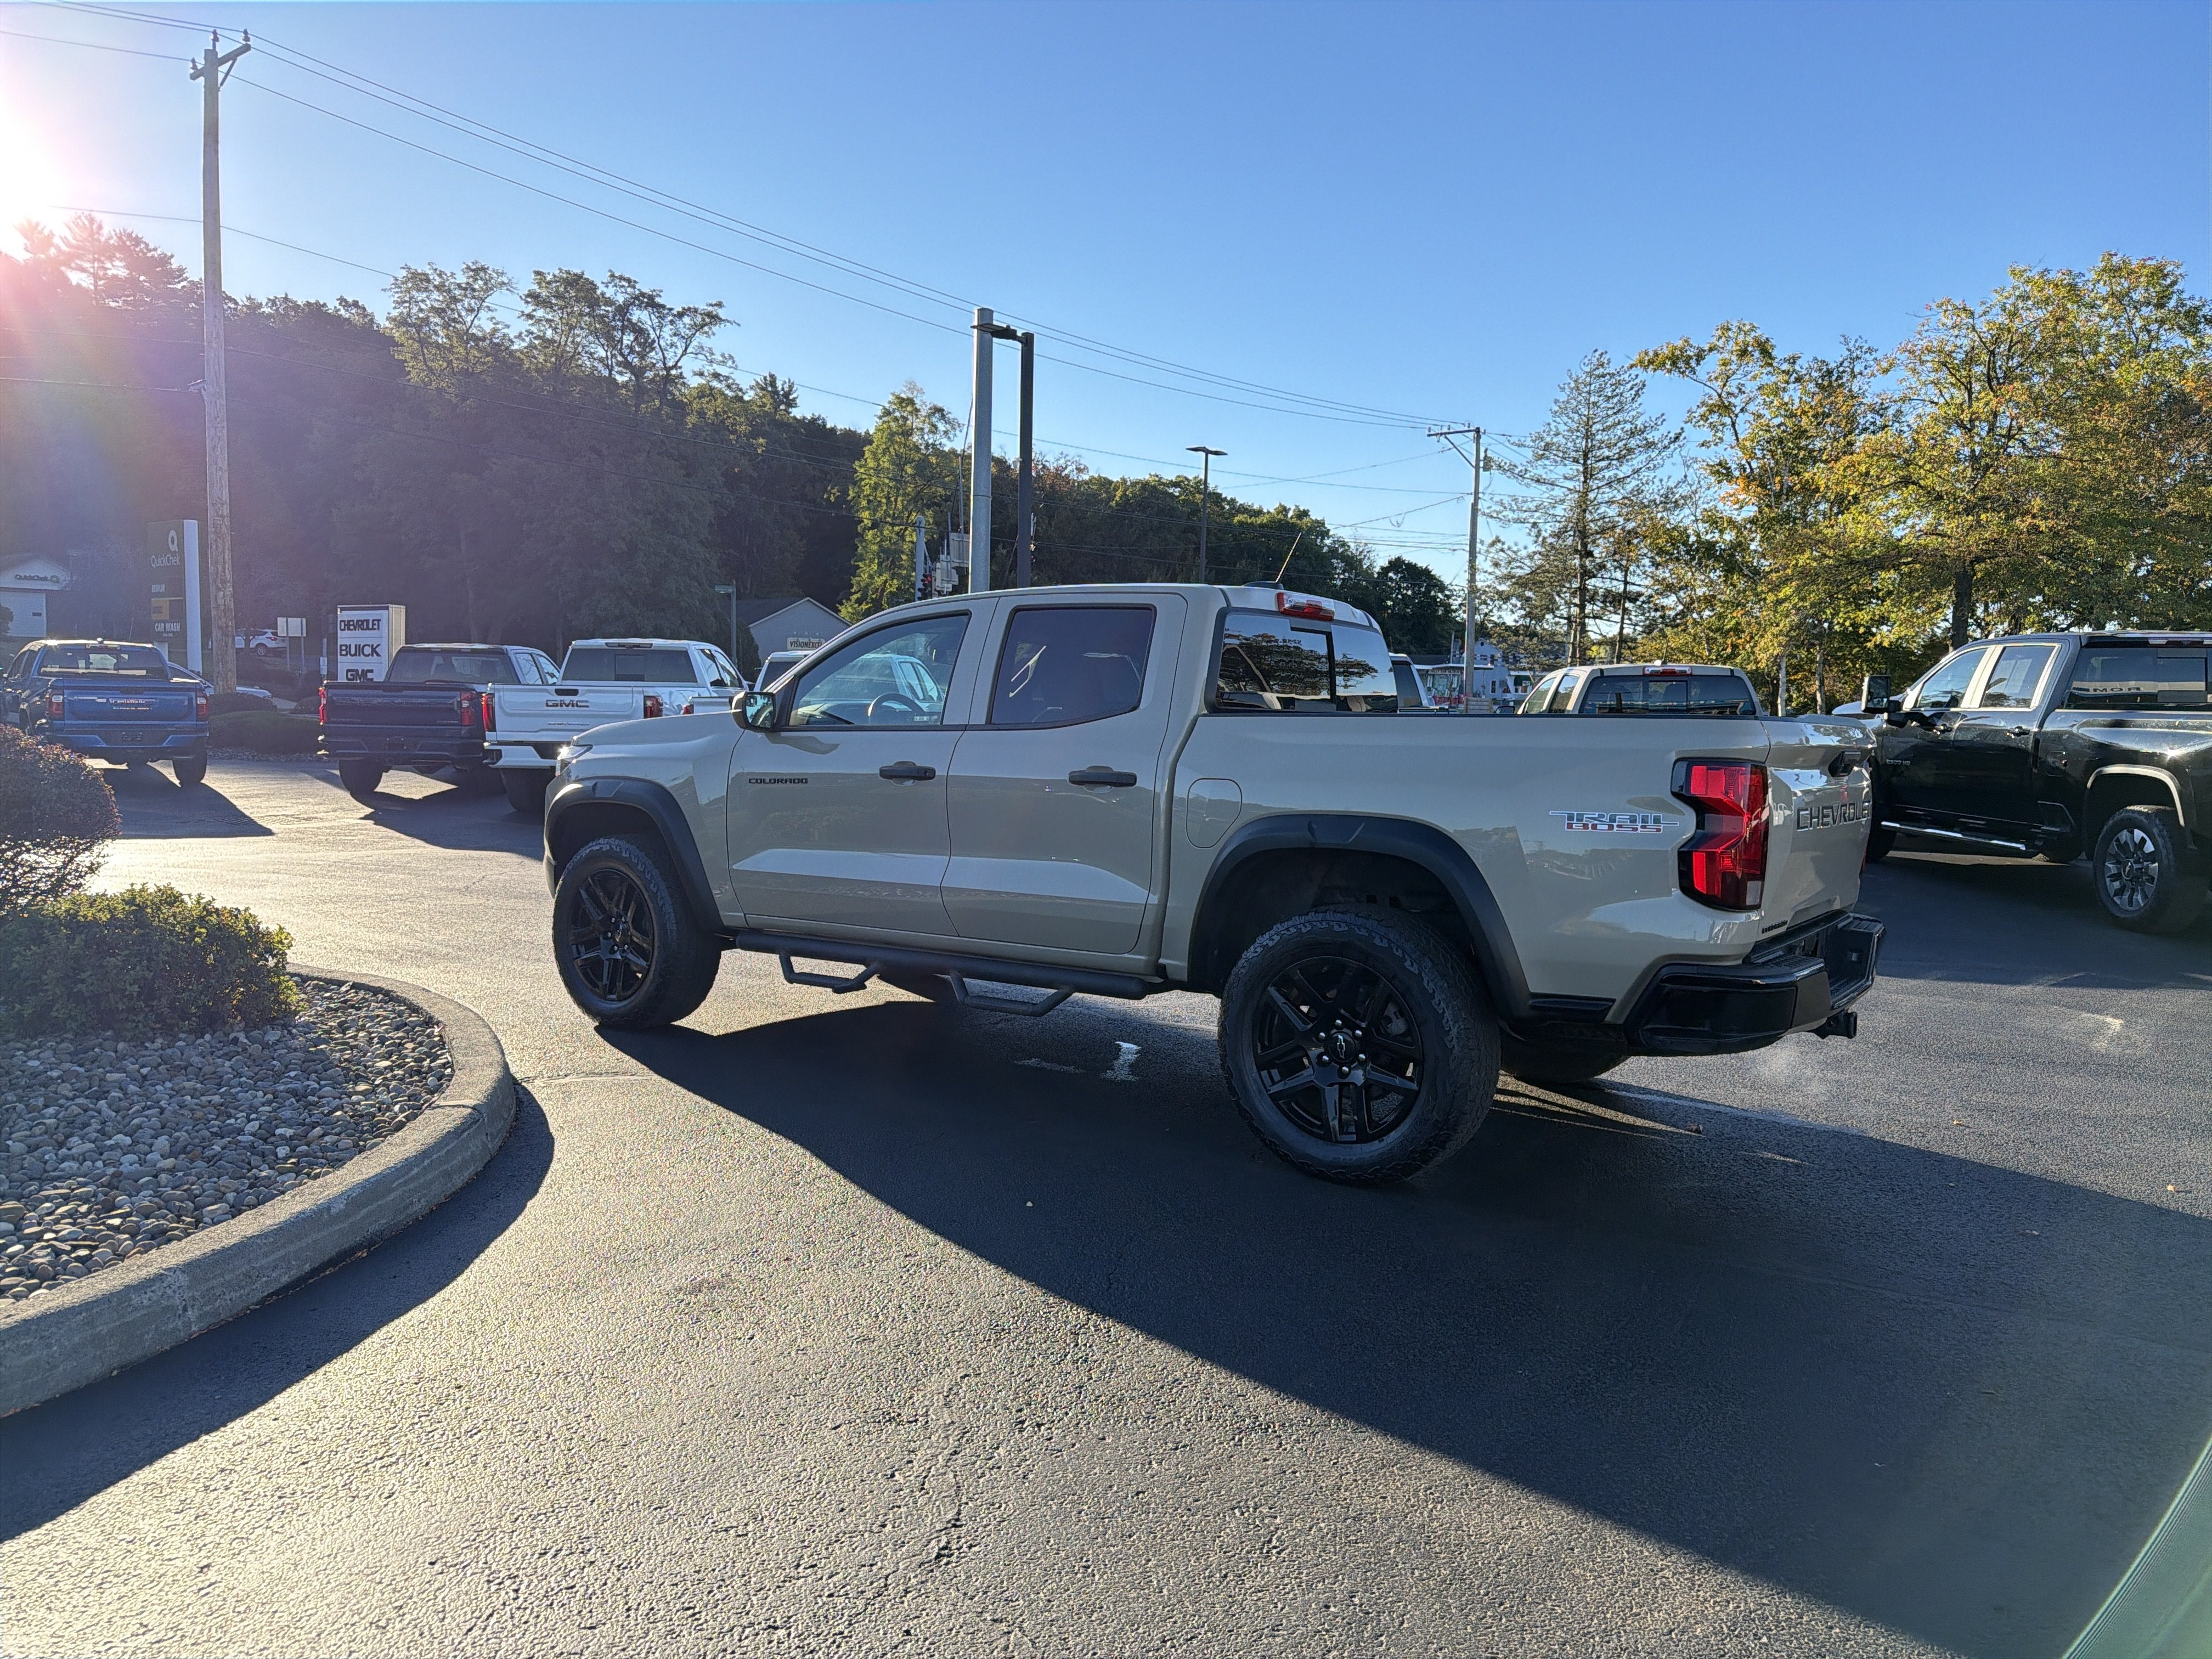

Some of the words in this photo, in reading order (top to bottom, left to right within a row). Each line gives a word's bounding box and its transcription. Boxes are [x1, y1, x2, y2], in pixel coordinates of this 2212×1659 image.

[151, 553, 180, 569] QuickChek
[155, 623, 164, 632] CAR
[166, 623, 180, 632] WASH
[340, 619, 381, 631] CHEVROLET
[340, 644, 381, 657] BUICK
[346, 668, 374, 681] GMC
[545, 699, 590, 708] GMC
[1549, 810, 1680, 826] TRAIL
[1565, 823, 1663, 834] BOSS
